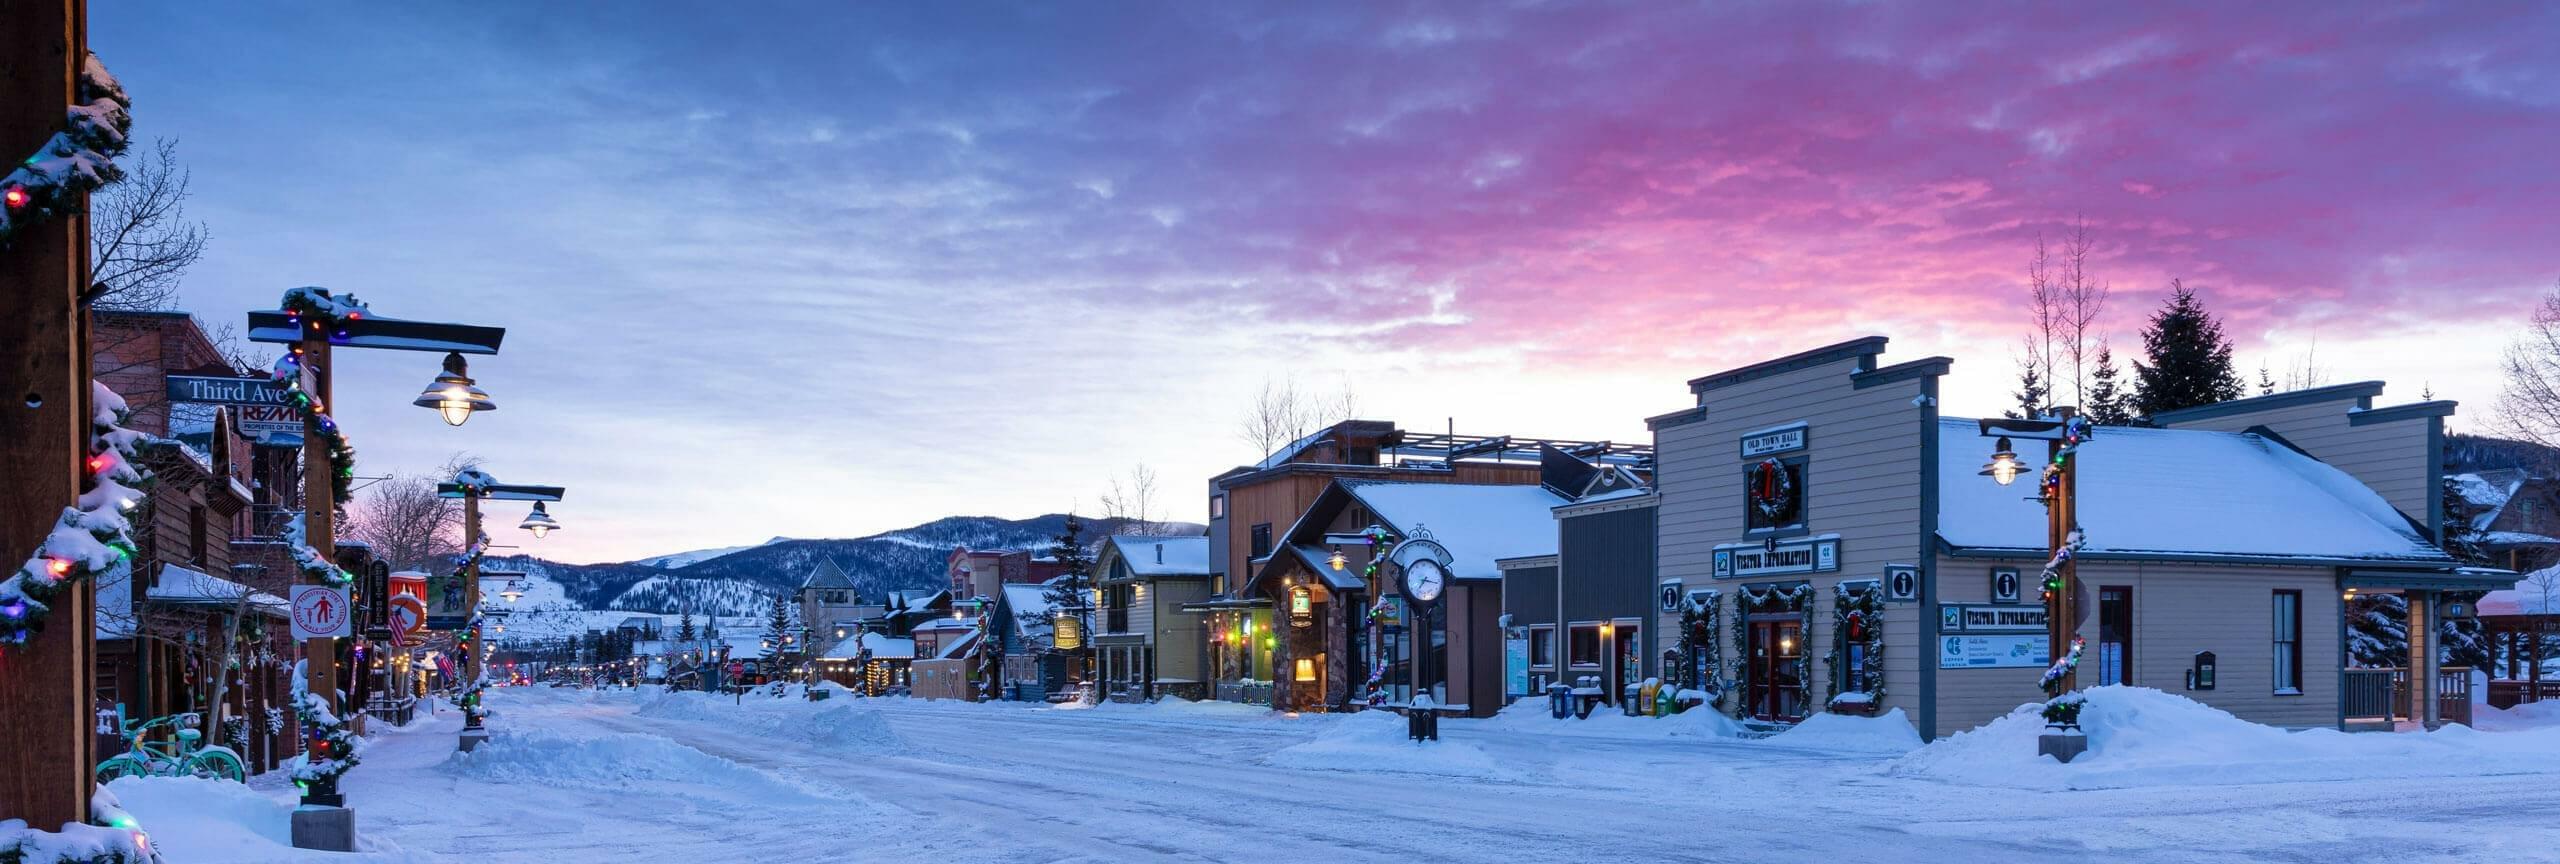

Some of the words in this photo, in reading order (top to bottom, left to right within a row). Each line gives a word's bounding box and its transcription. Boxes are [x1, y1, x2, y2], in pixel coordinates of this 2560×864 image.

[188, 380, 245, 400] Third
[252, 384, 288, 403] Ave
[1747, 440, 1759, 449] OLD
[1762, 436, 1780, 447] TOWN
[1781, 432, 1798, 443] HALL
[1736, 554, 1762, 570] VISITOR
[1764, 549, 1811, 568] INFORMATION
[1967, 611, 1995, 625] VISITOR
